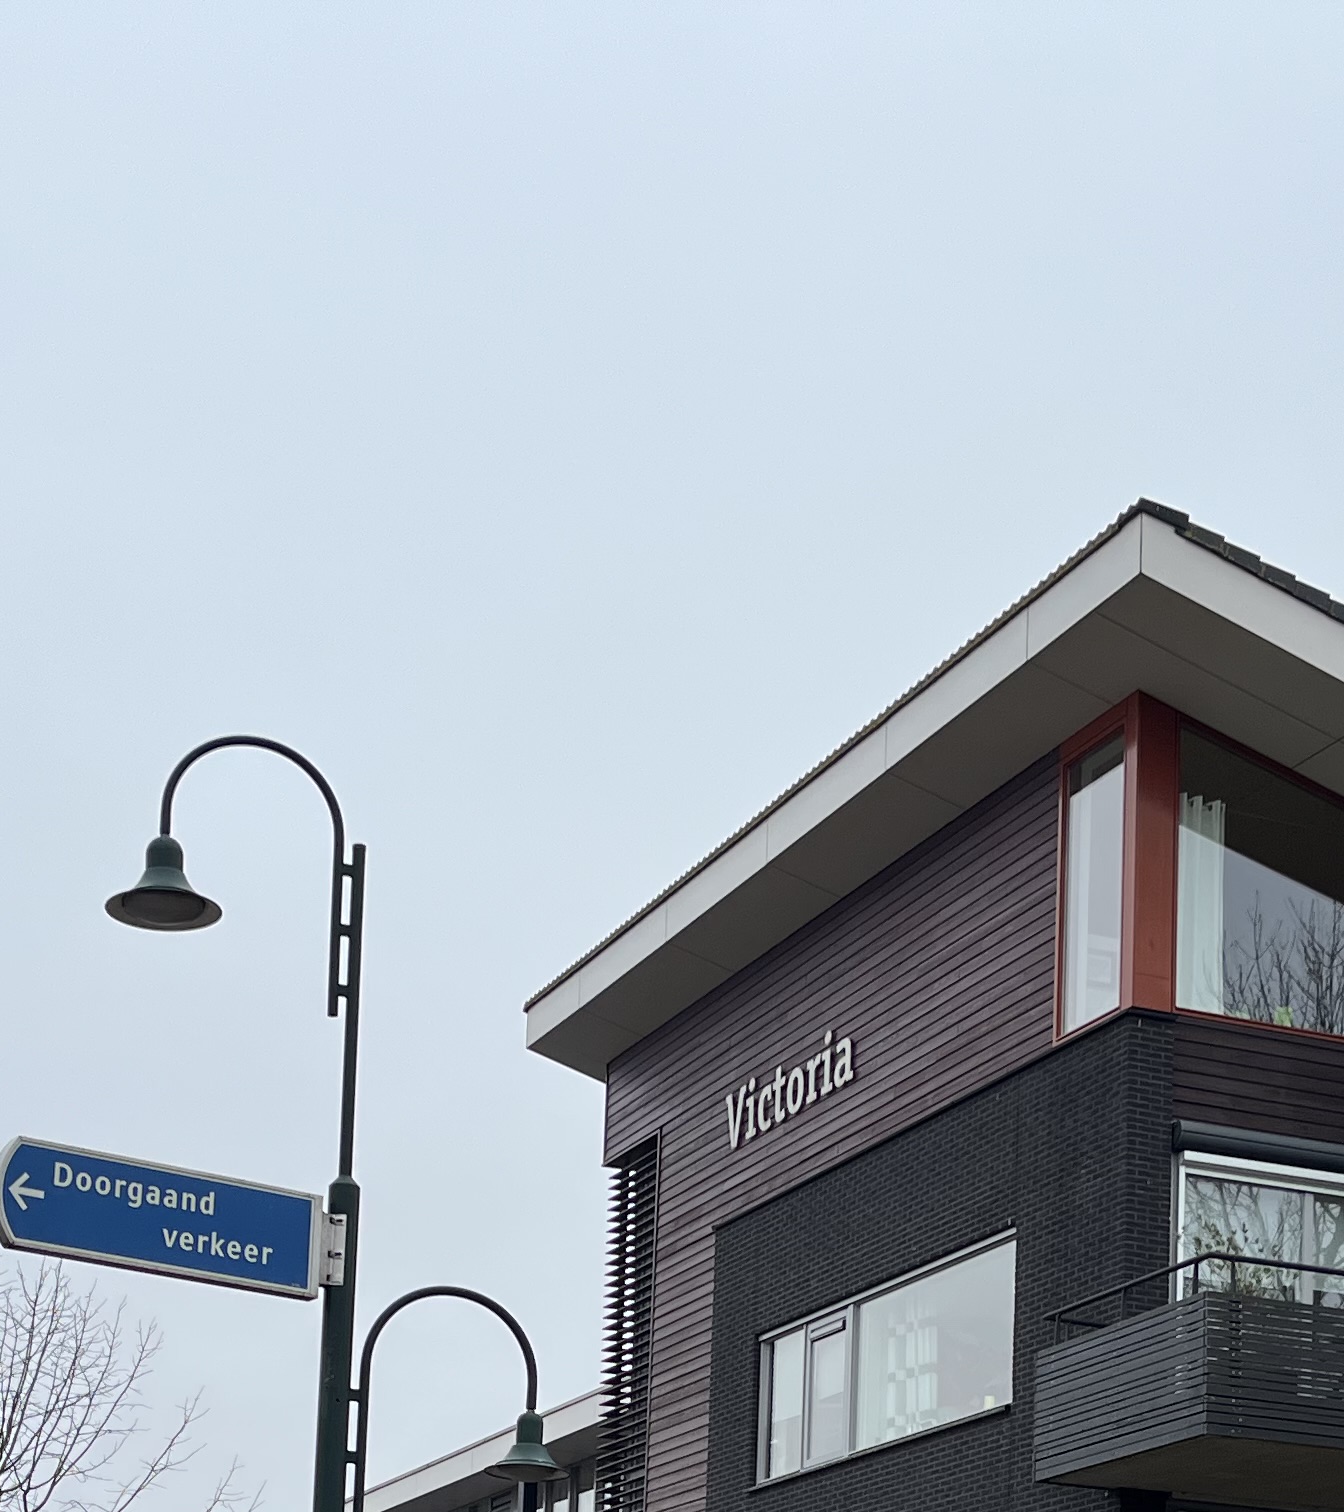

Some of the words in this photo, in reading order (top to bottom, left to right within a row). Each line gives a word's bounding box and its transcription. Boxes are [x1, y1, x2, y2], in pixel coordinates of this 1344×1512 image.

[725, 1029, 854, 1150] Victoria
[53, 1161, 216, 1217] Doorgaand
[162, 1227, 274, 1265] verkeer
